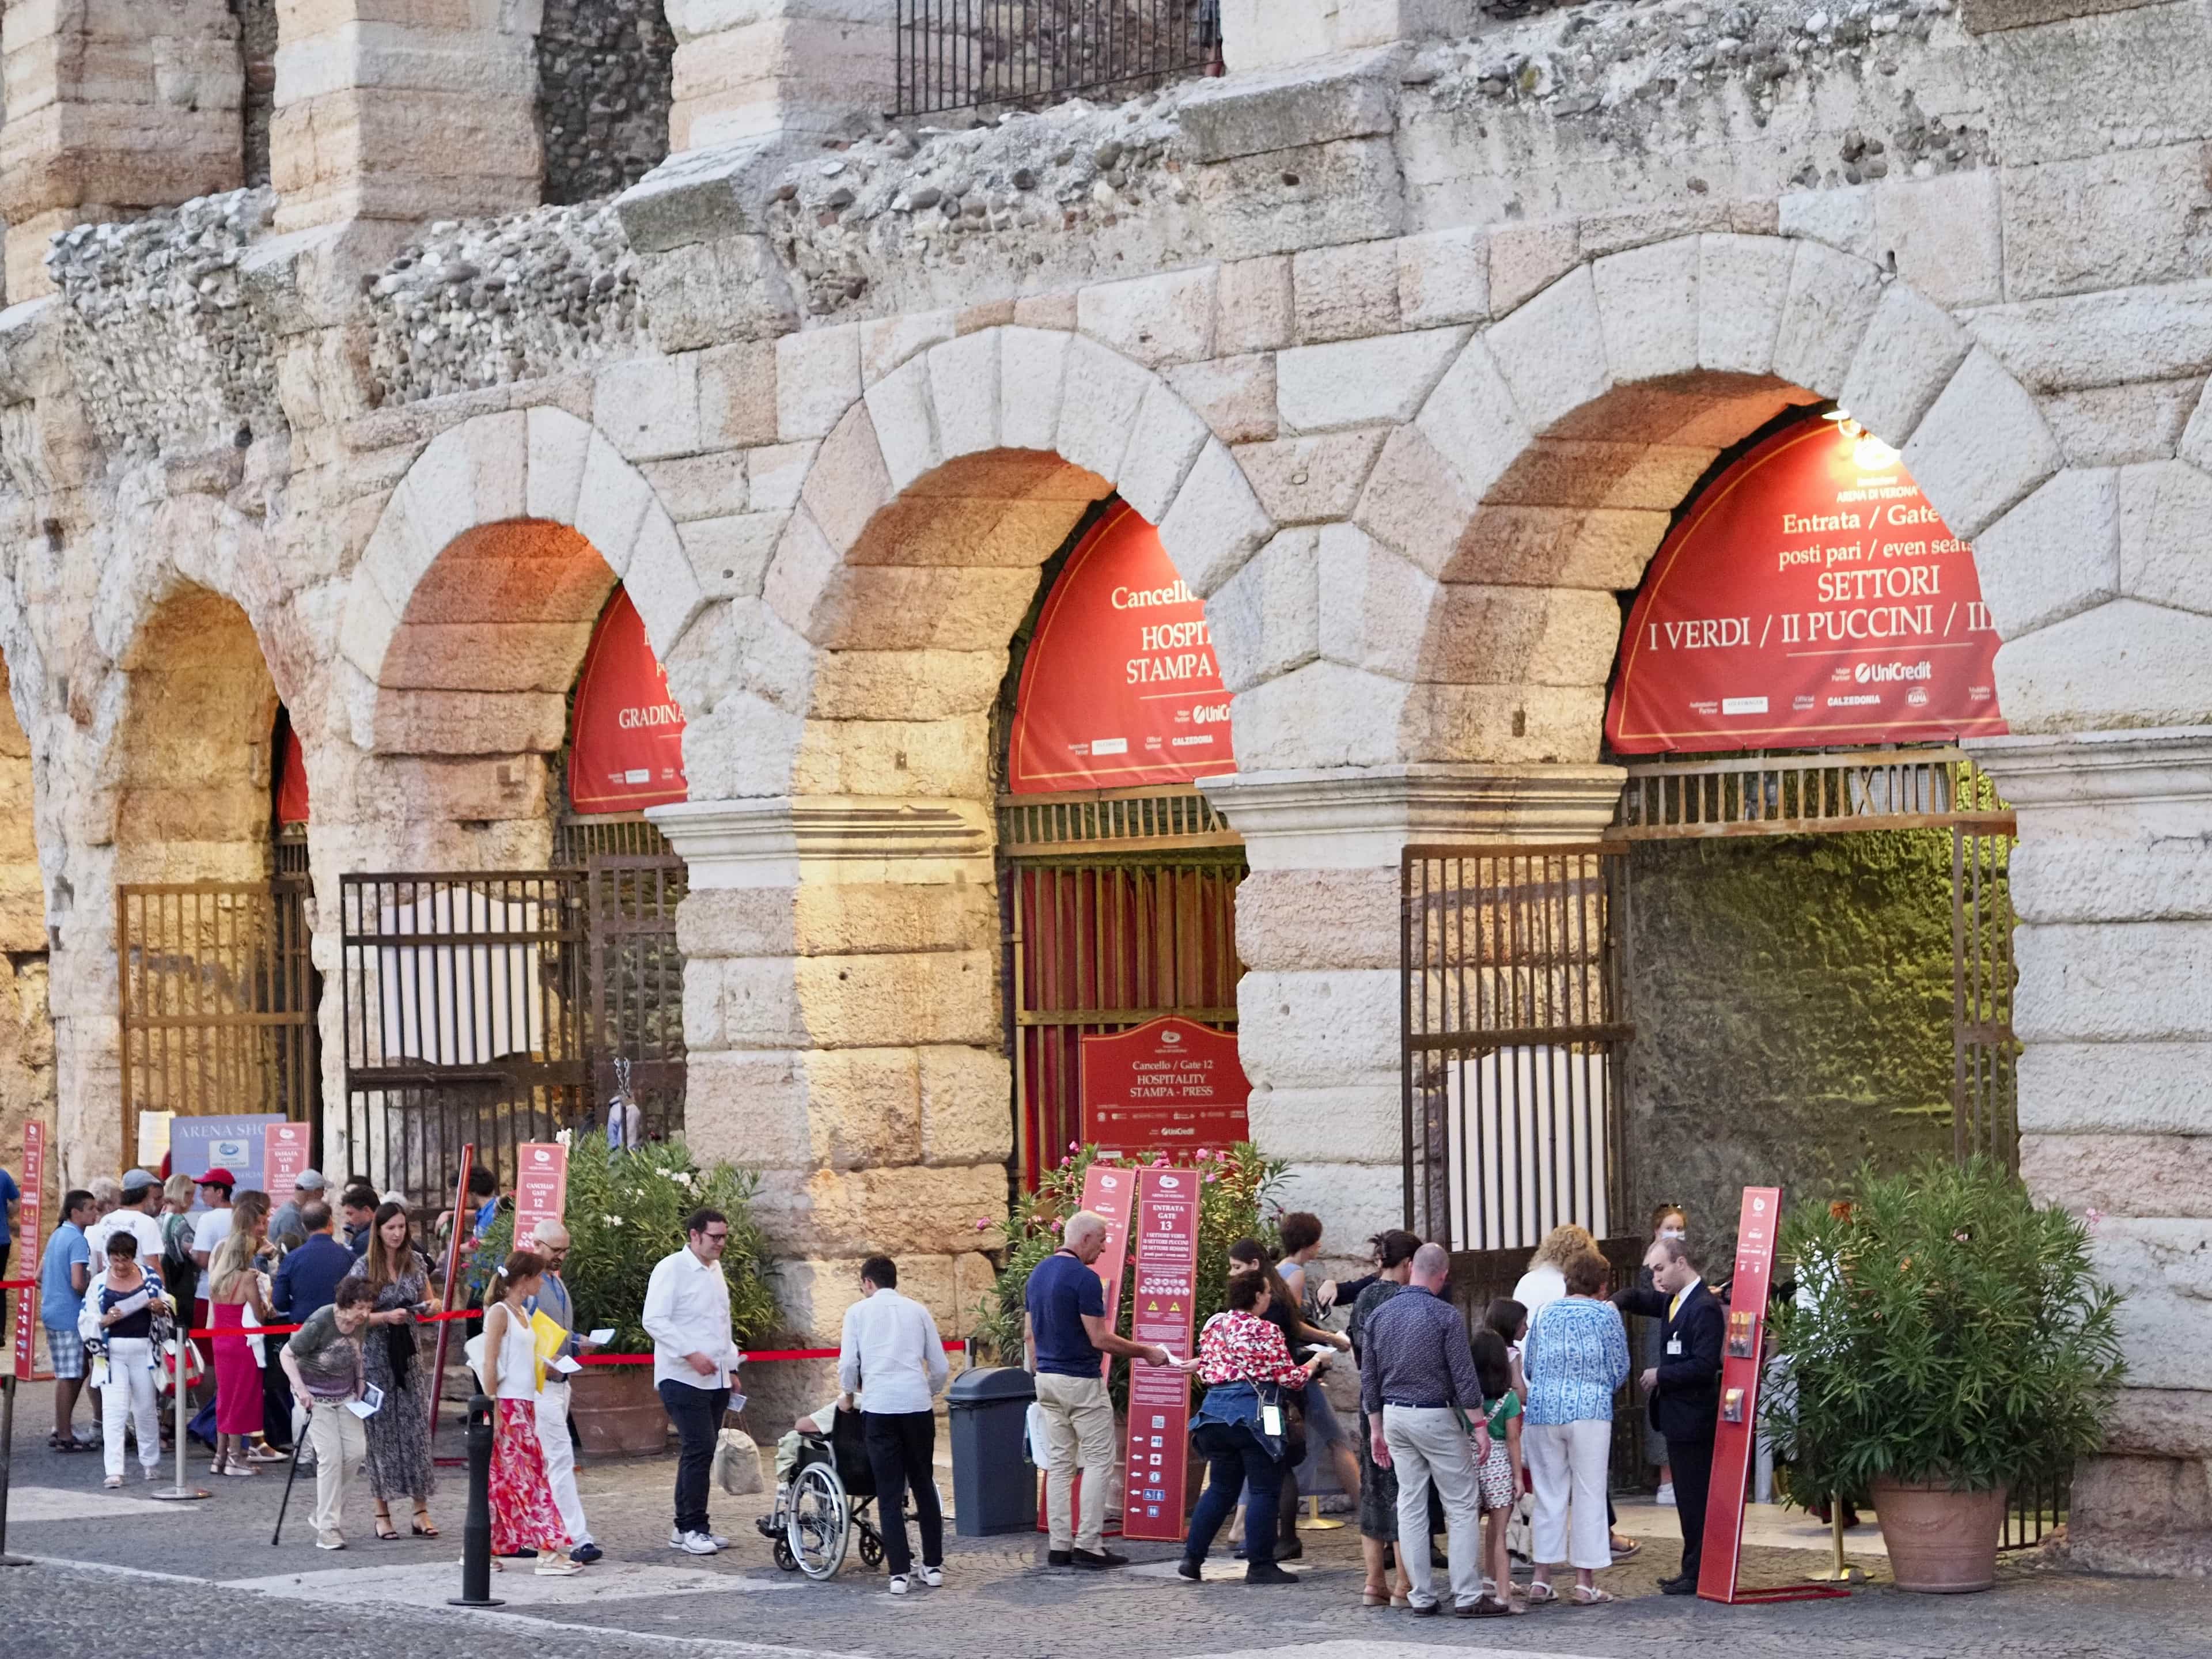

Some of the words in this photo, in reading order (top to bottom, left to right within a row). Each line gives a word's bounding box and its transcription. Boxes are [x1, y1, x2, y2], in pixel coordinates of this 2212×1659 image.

[1836, 490, 1867, 503] ARENA
[1868, 488, 1879, 500] DI
[1782, 512, 1861, 535] Entrata
[1868, 506, 1881, 531] /
[1887, 504, 1940, 526] Gate
[1779, 544, 1821, 571] posti
[1825, 541, 1862, 569] pari
[1867, 538, 1878, 562] /
[1883, 540, 1926, 558] even
[1817, 565, 1941, 603] SETTORI
[1649, 623, 1658, 651] I
[1664, 617, 1750, 649] VERDI
[1759, 614, 1772, 648] /
[1781, 613, 1801, 643] II
[1808, 605, 1934, 642] PUCCINI
[1943, 602, 1957, 637] /
[1126, 653, 1213, 684] STAMPA
[1871, 661, 1931, 682] UniCredit
[1827, 695, 1881, 707] CALZEDONIA
[1172, 734, 1213, 746] CALZEDONIA
[1132, 1060, 1171, 1070] Cancello
[1180, 1060, 1201, 1070] Gate
[1203, 1060, 1213, 1069] 12
[1137, 1074, 1206, 1085] HOSPITALITY
[1130, 1086, 1174, 1097] STAMPA
[1183, 1086, 1213, 1096] PRESS
[179, 1125, 233, 1138] ARENA
[281, 1164, 289, 1172] 11
[533, 1198, 543, 1207] 12
[1160, 1221, 1172, 1231] 13
